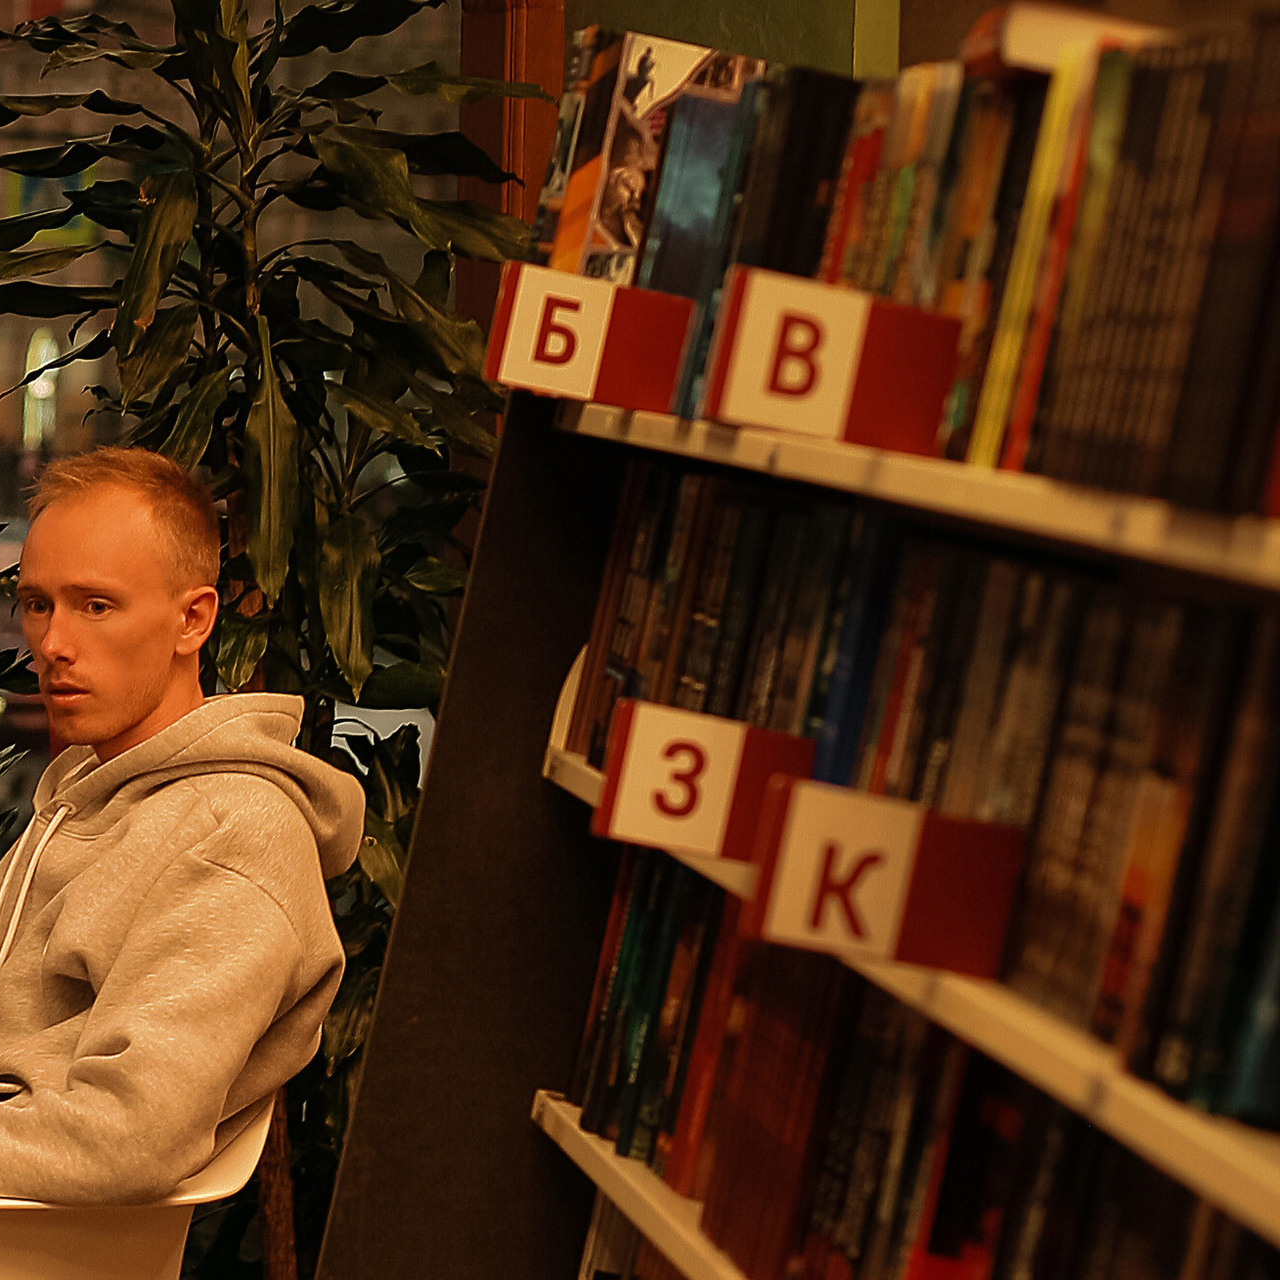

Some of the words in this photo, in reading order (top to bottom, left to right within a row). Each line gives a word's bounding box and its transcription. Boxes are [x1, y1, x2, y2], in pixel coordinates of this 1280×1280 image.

[533, 296, 582, 366] Б
[765, 310, 825, 400] В
[807, 841, 885, 942] К
